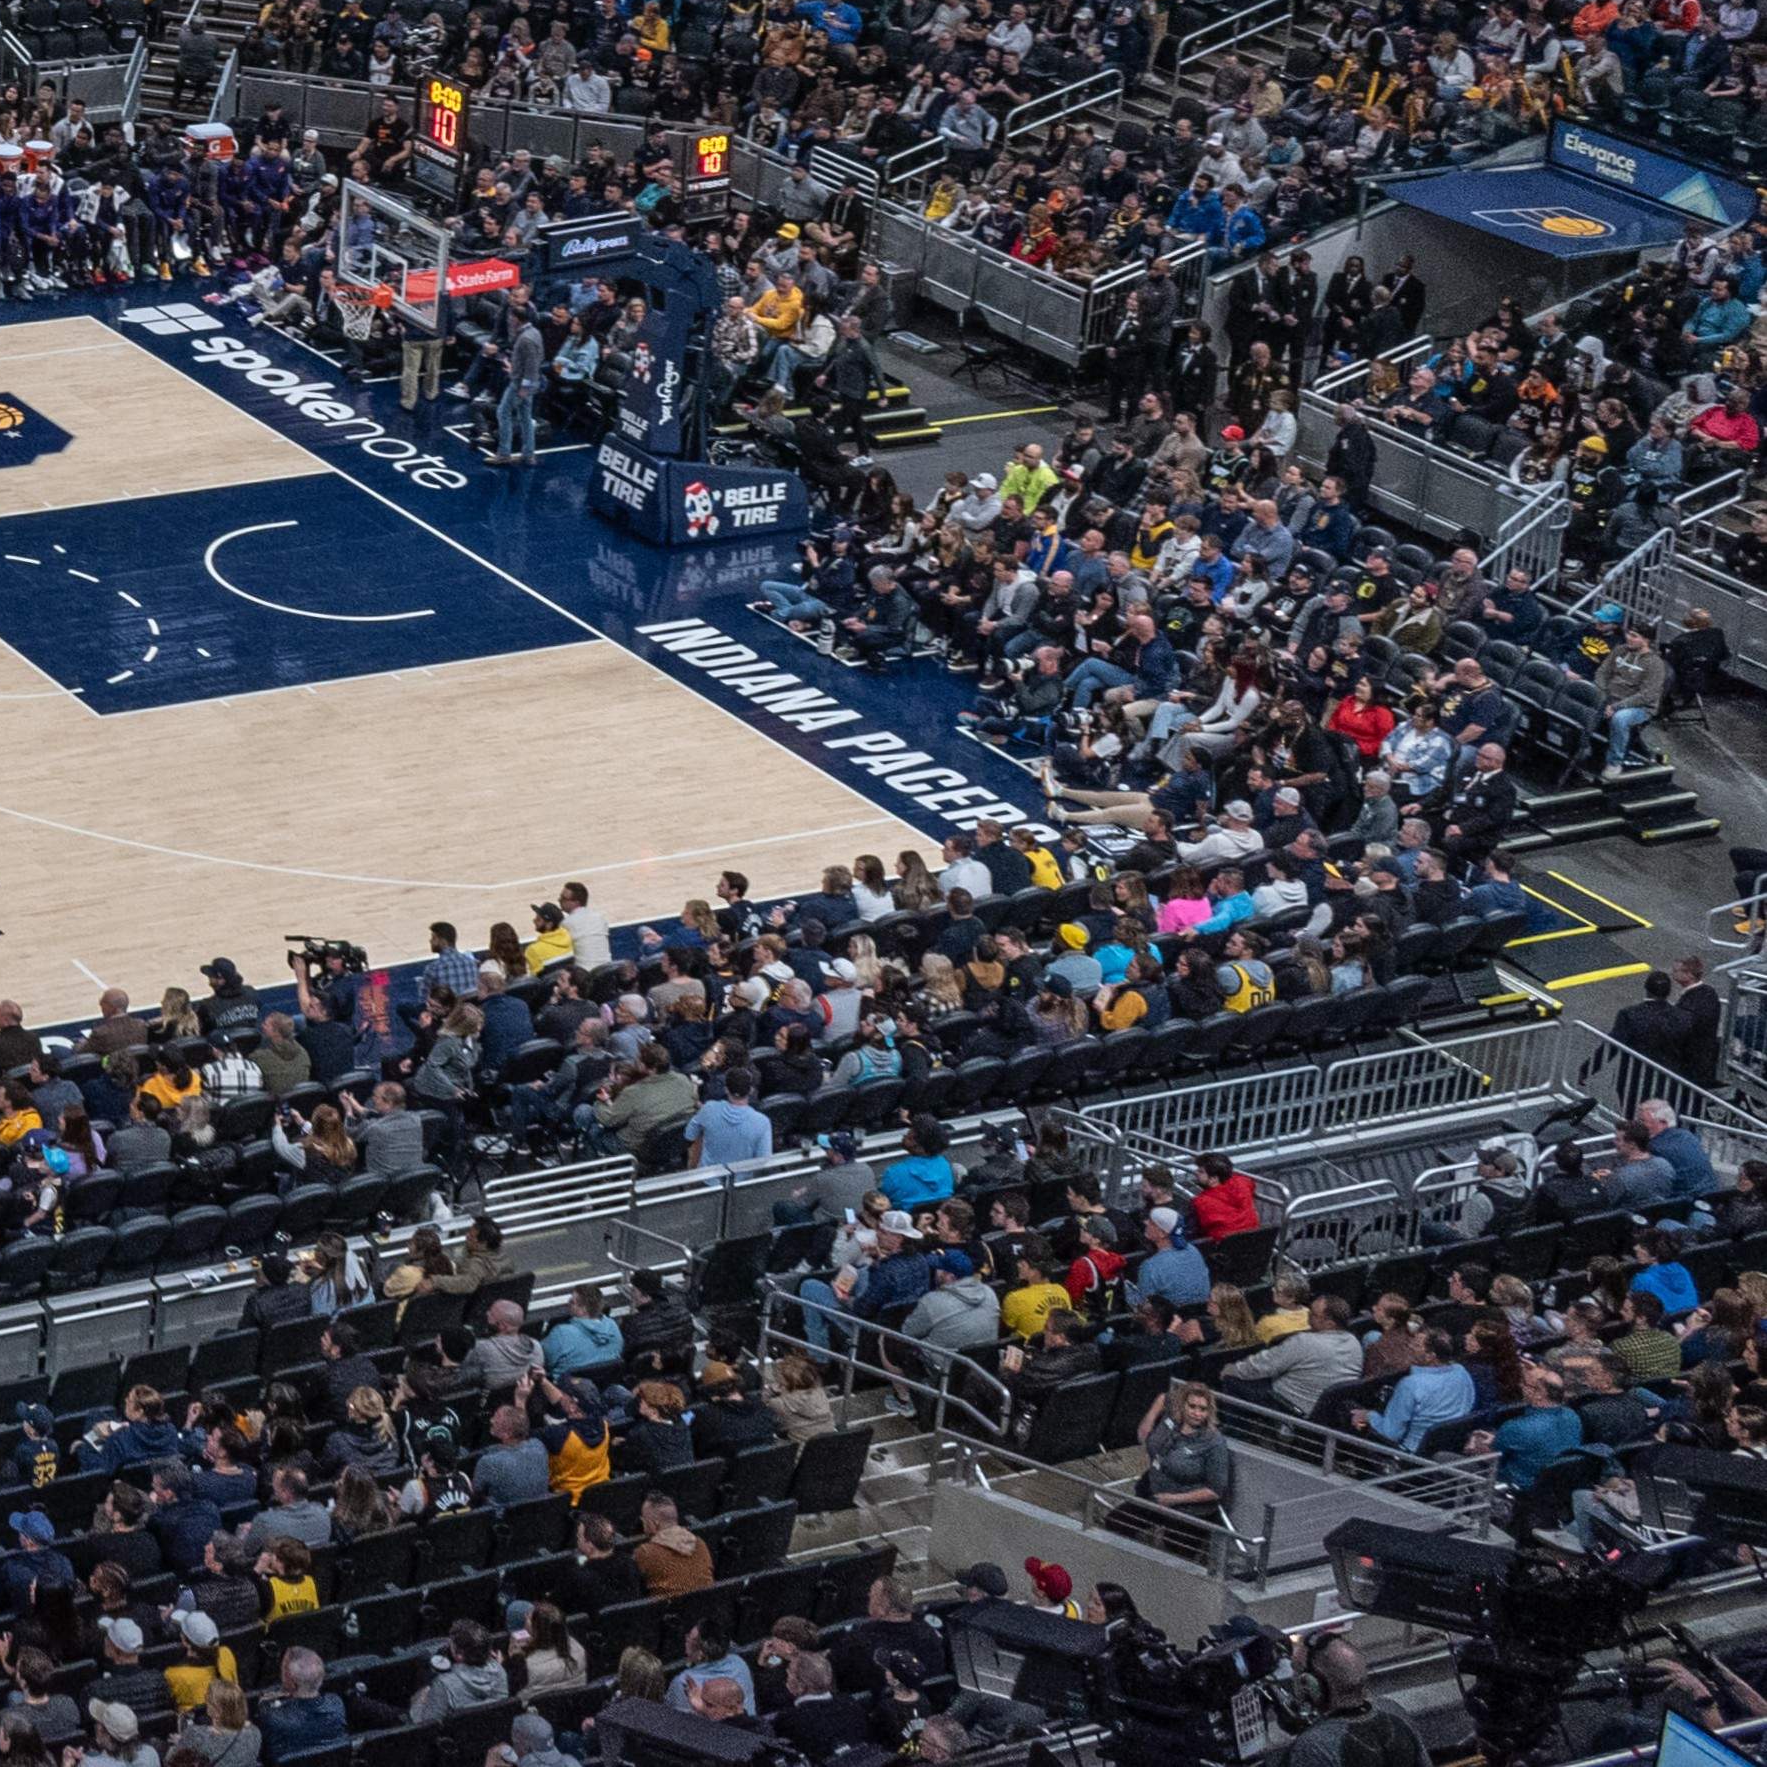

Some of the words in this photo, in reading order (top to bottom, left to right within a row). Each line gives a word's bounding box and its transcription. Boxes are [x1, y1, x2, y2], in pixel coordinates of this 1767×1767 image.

[431, 81, 462, 112] 8:00
[434, 109, 456, 147] 10
[699, 135, 727, 155] 8:00
[703, 153, 721, 173] 10
[1564, 133, 1637, 172] Elevance
[457, 269, 513, 287] StateFarm
[192, 336, 468, 489] spokenote
[597, 445, 658, 491] BELLE
[602, 471, 644, 510] TIRE
[723, 482, 786, 508] BELLE
[731, 503, 779, 526] TIRE
[636, 618, 863, 733] INDIANA
